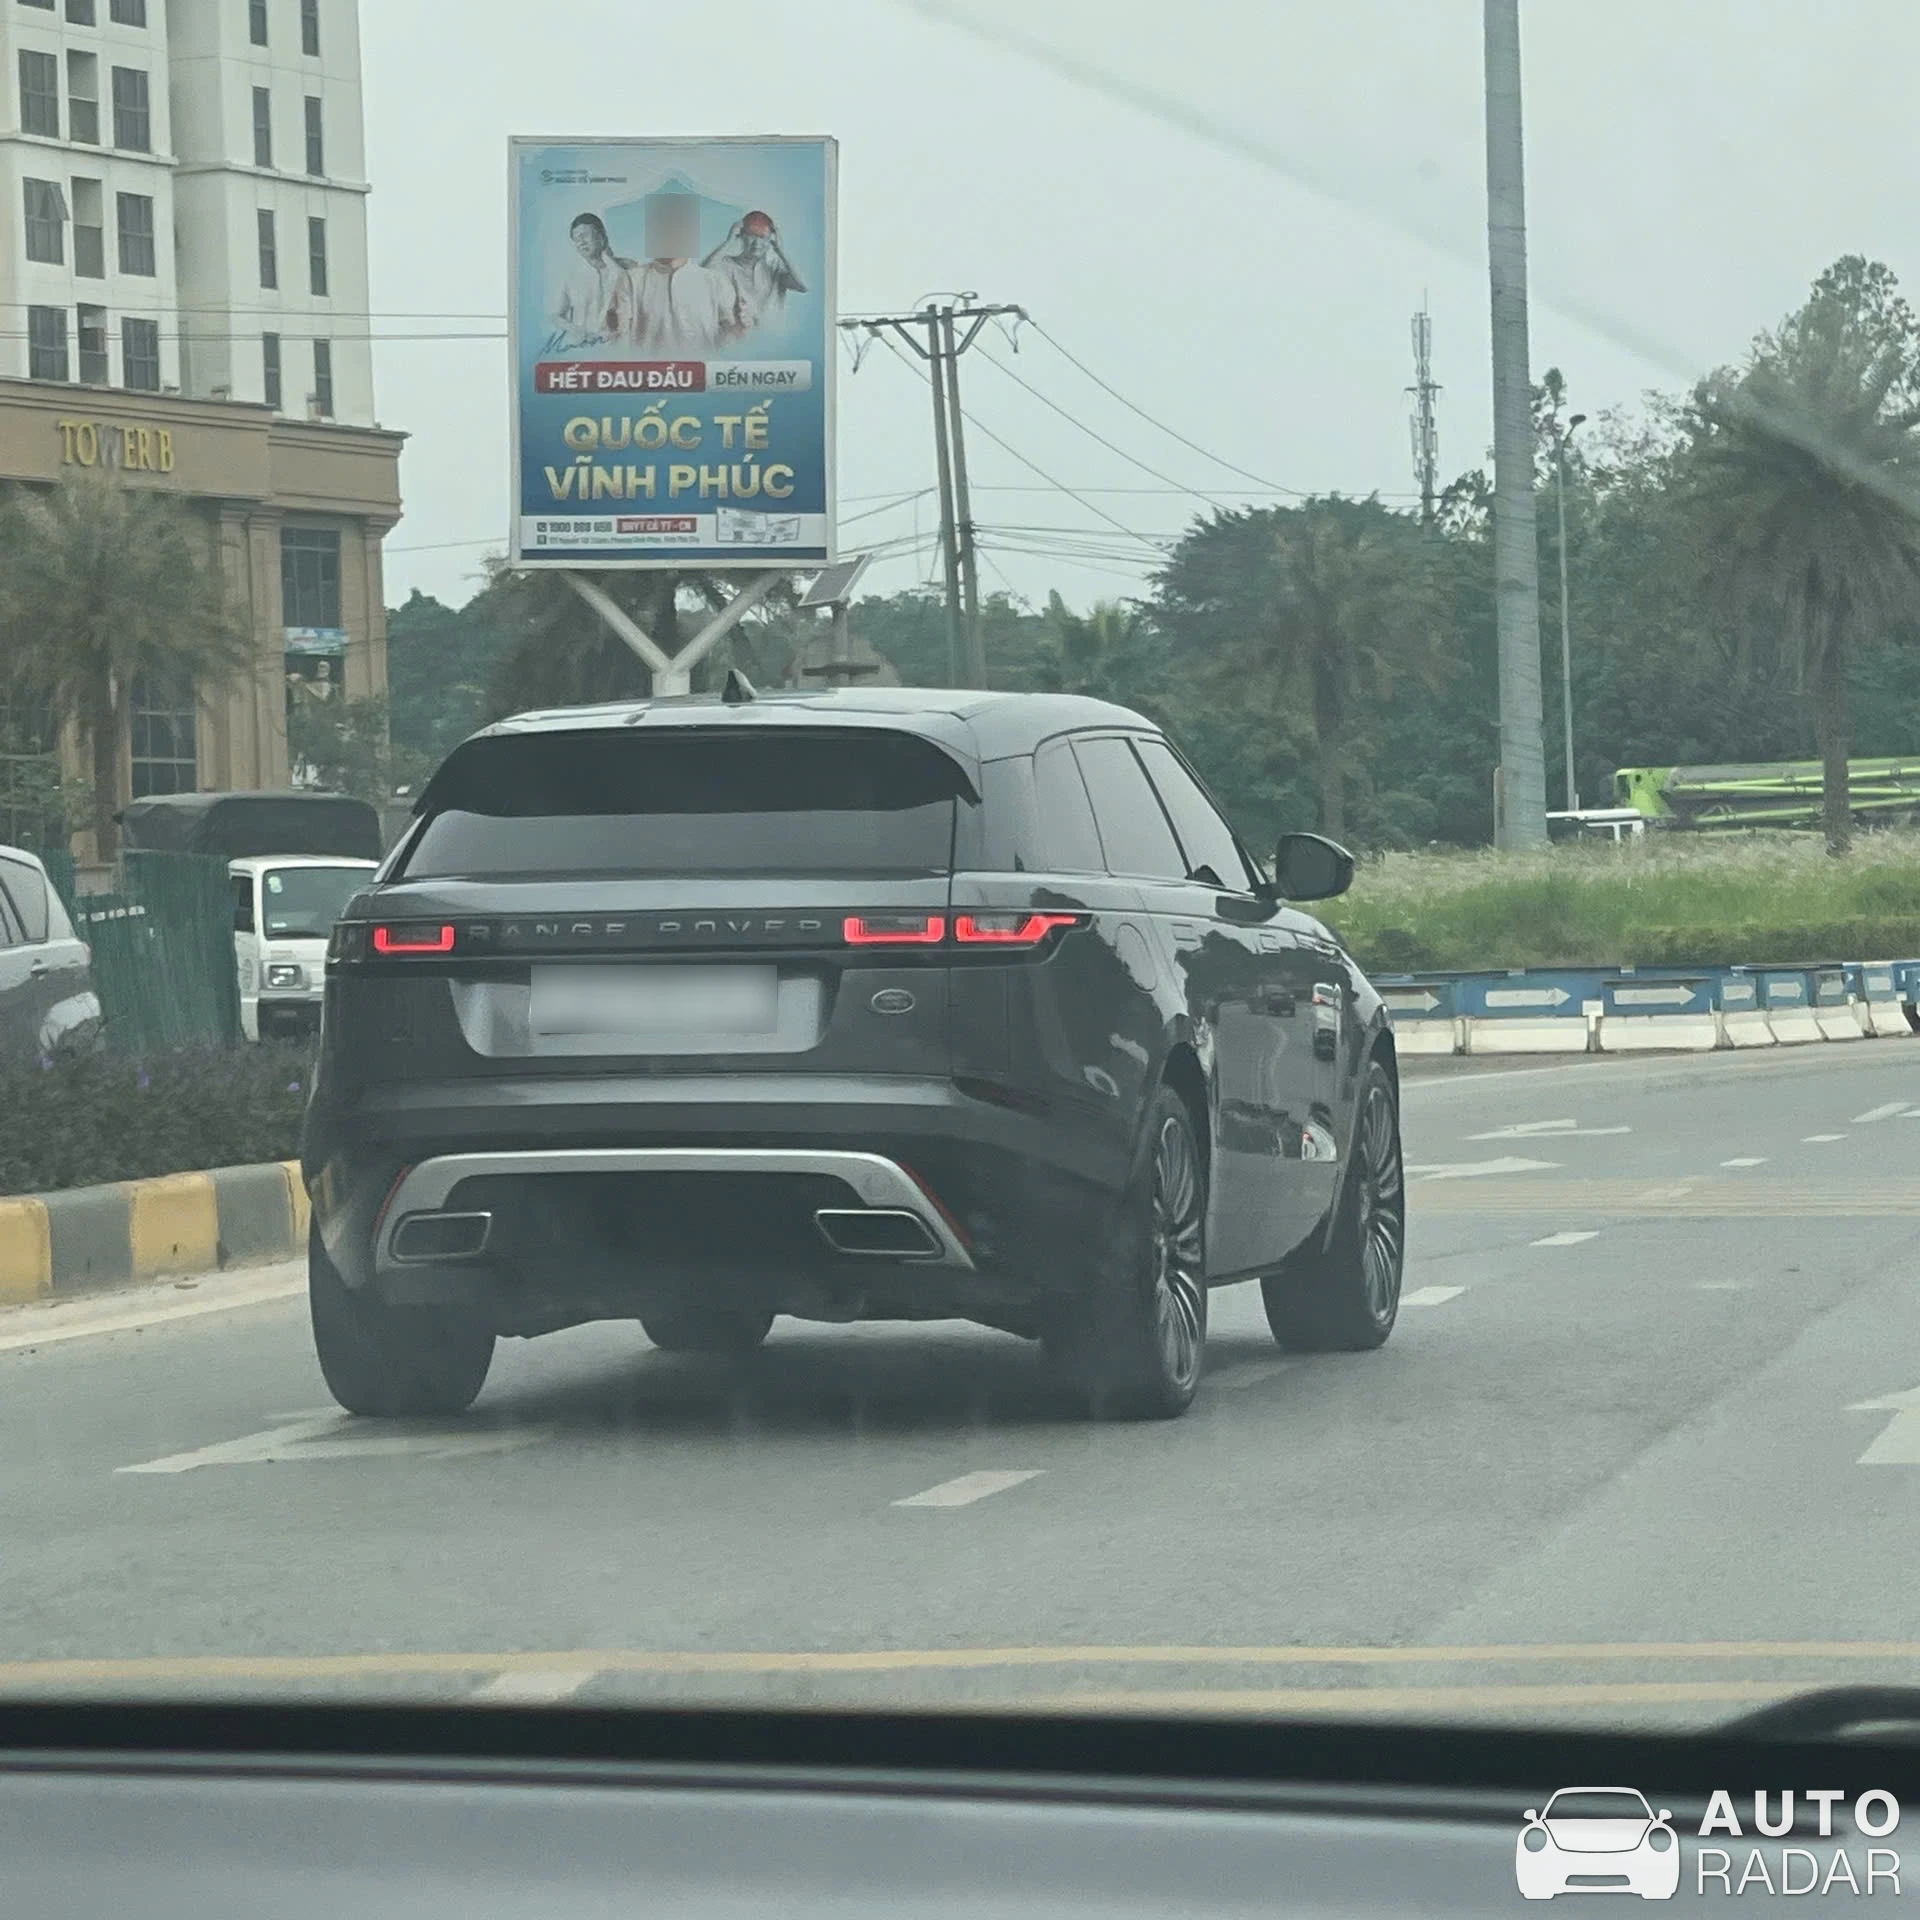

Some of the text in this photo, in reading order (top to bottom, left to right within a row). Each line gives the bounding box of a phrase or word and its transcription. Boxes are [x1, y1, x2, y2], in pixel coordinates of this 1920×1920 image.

[549, 364, 590, 389] HẾT
[597, 371, 641, 388] ĐAU
[715, 367, 797, 386] ĐẾN NGAY
[59, 419, 175, 473] TOWER B
[563, 400, 774, 450] QUỐC TẾ
[544, 454, 795, 500] VĨNH PHÚC
